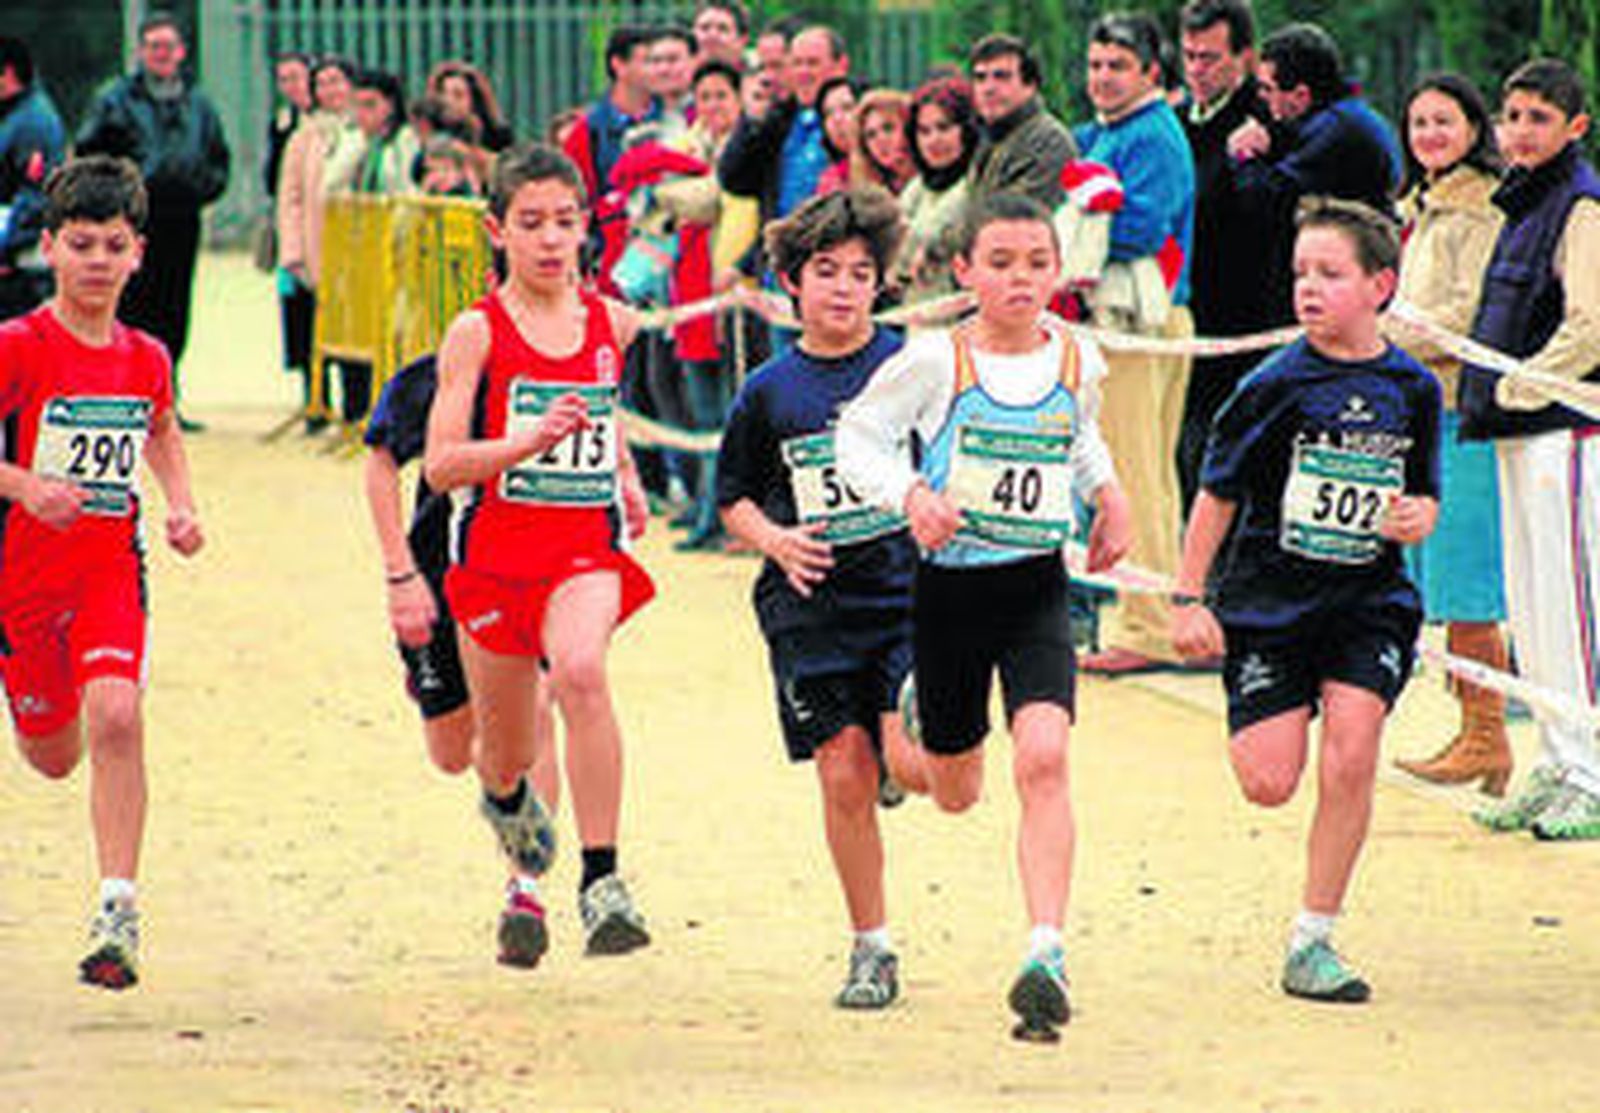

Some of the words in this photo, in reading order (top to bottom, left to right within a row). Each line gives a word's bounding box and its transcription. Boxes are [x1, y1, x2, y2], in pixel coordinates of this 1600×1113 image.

[68, 433, 134, 477] 290
[993, 467, 1042, 513] 40
[1313, 483, 1381, 529] 502
